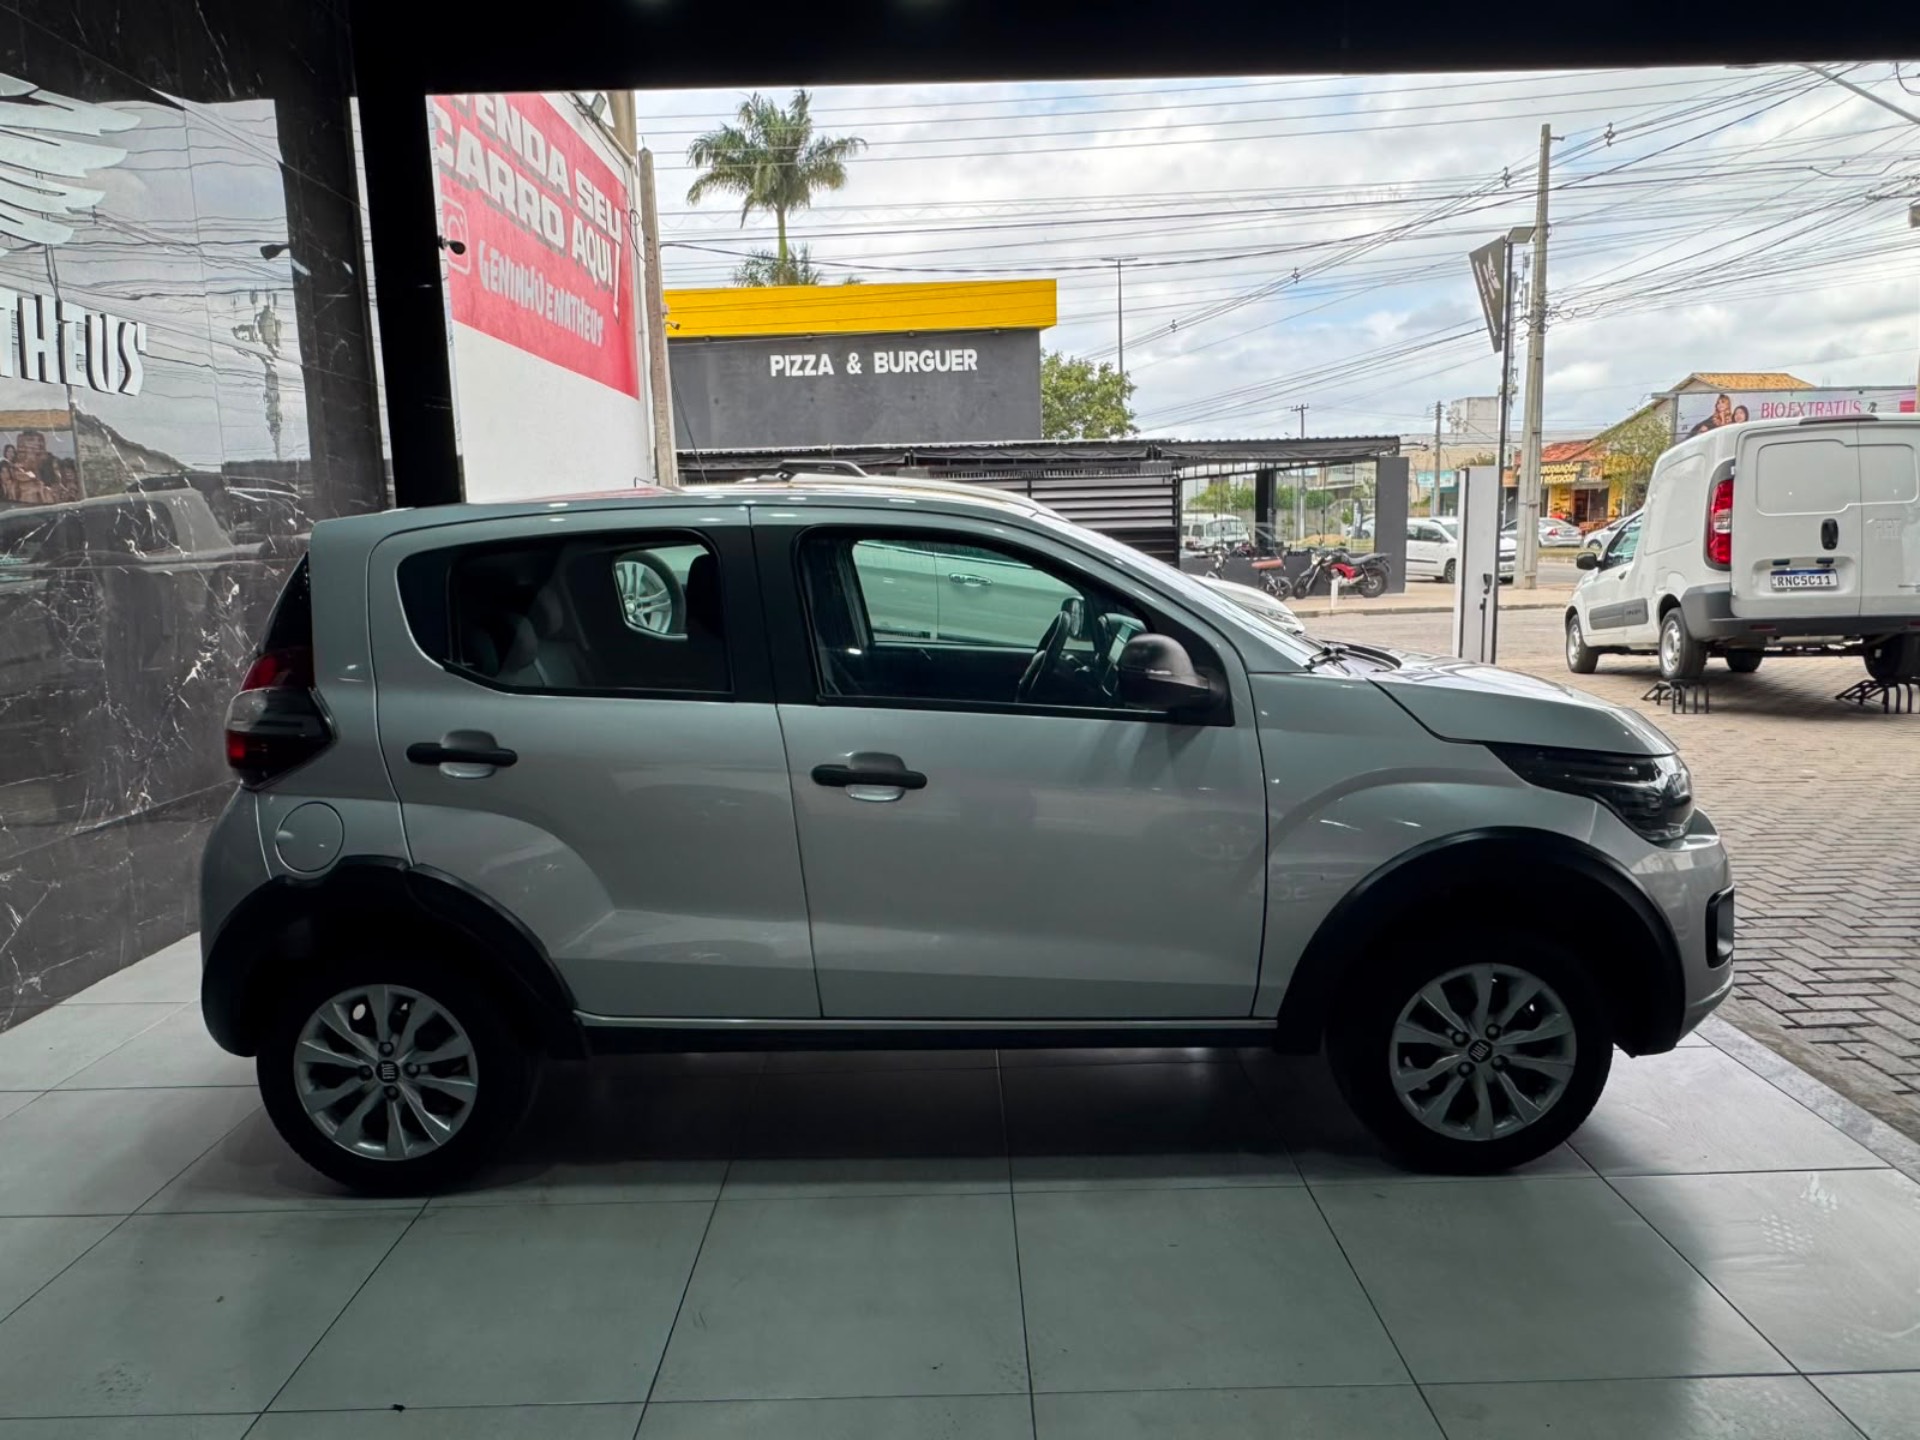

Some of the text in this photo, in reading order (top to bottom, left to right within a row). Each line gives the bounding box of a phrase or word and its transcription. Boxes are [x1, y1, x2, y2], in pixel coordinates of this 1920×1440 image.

[452, 94, 621, 243] ENDA SEU
[769, 349, 978, 377] PIZZA & BURGUER
